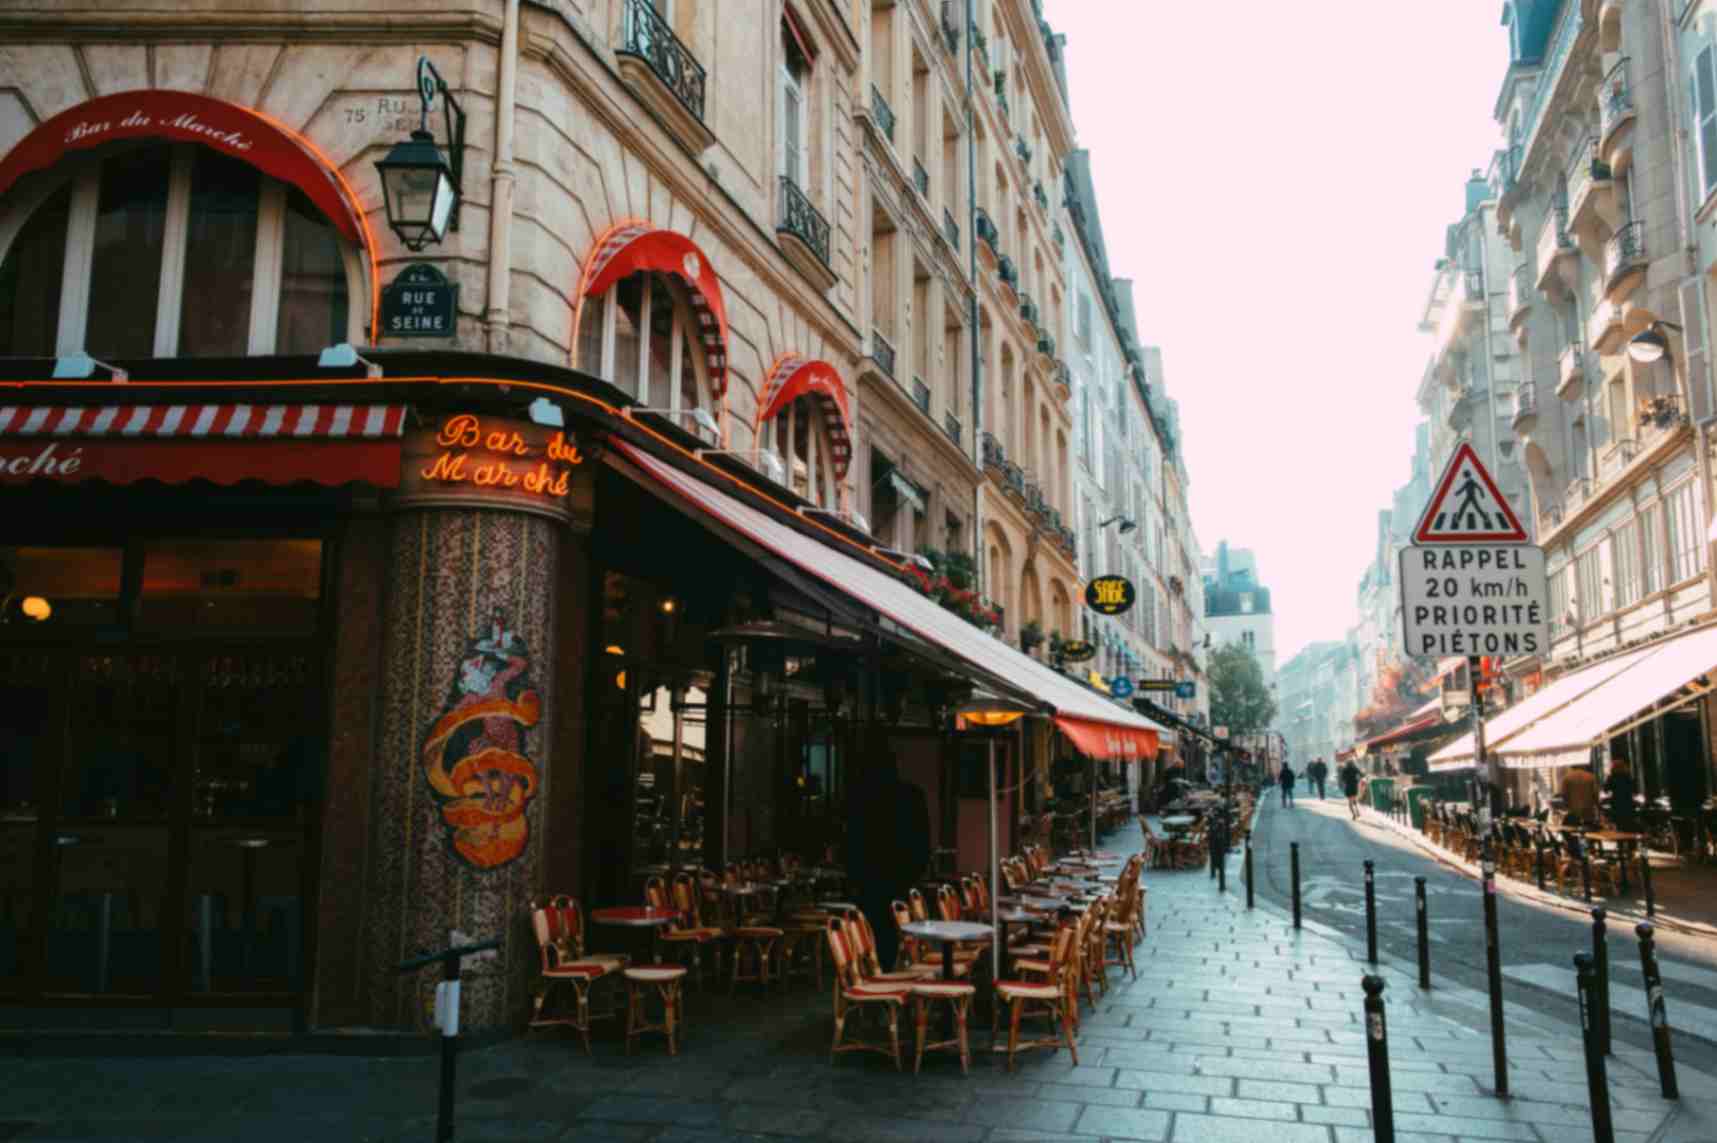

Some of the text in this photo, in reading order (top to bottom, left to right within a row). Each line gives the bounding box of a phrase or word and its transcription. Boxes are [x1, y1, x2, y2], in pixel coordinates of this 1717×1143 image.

[121, 110, 150, 127] du
[343, 109, 366, 124] 75
[402, 291, 435, 305] RUE
[391, 315, 444, 329] SEINE
[437, 414, 583, 464] Bar du
[421, 452, 570, 496] Marché
[1423, 549, 1525, 570] RAPPEL
[1425, 576, 1528, 598] 20 km/h
[1415, 600, 1541, 626] PRIORITÉ
[1422, 629, 1538, 653] PIÉTONS
